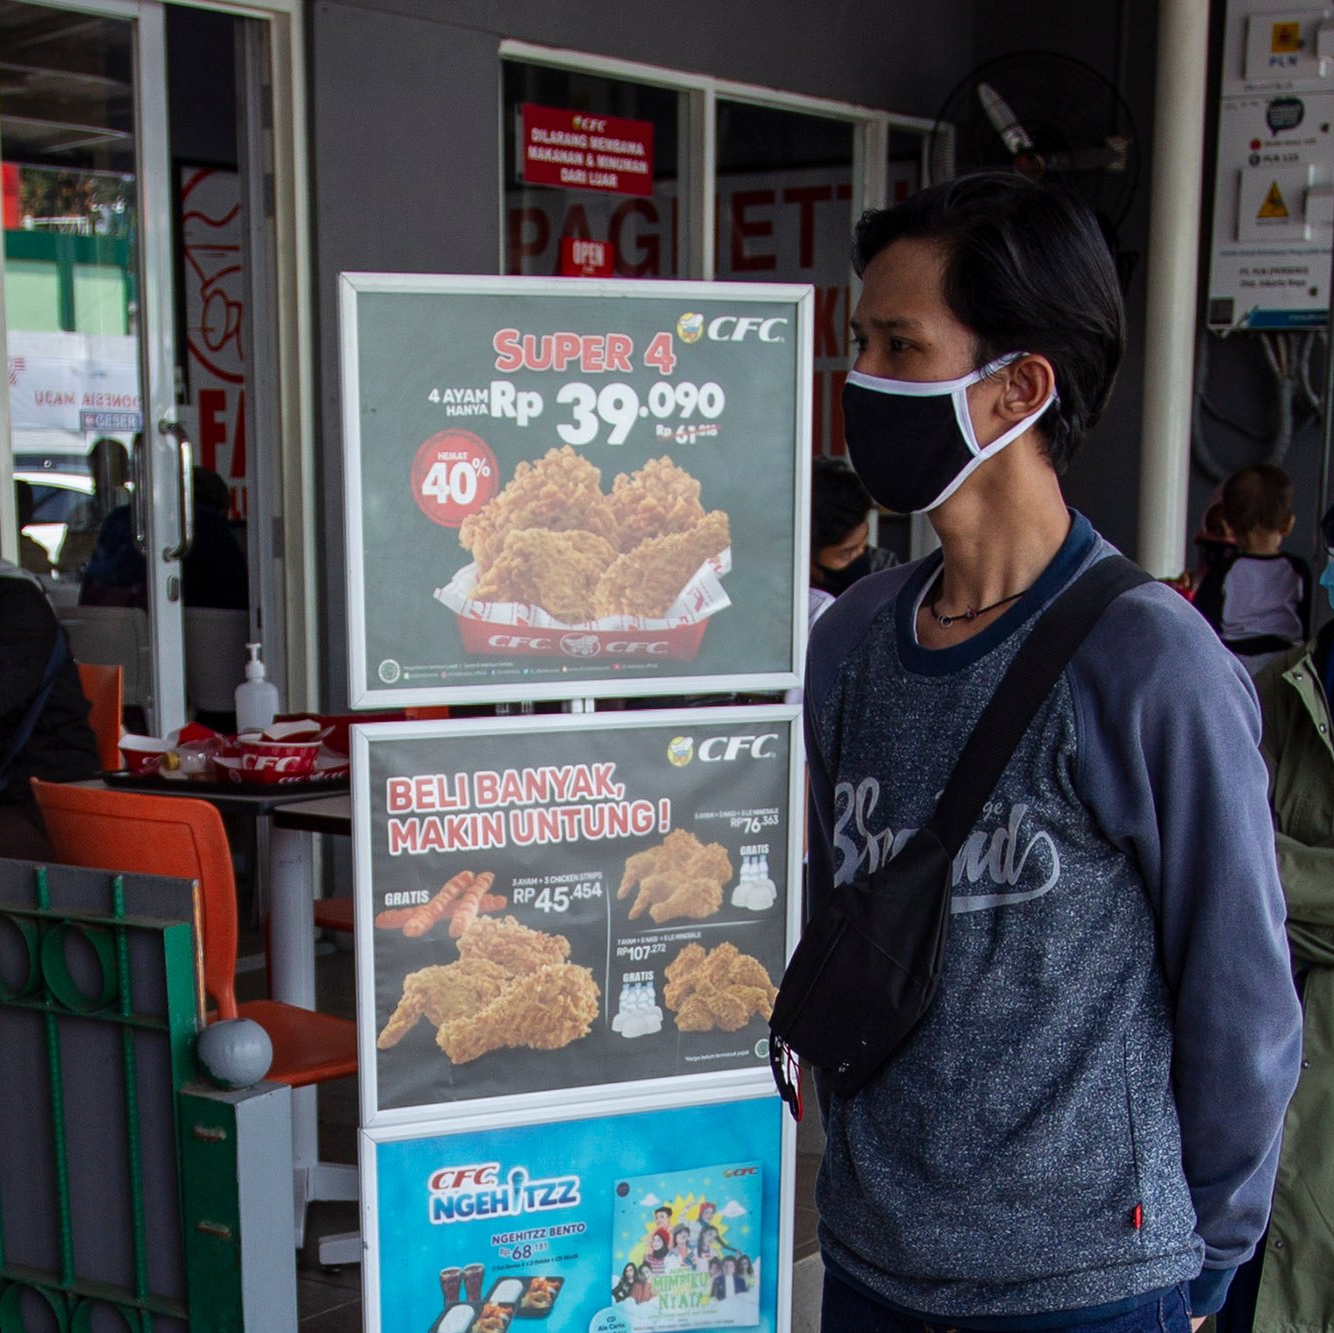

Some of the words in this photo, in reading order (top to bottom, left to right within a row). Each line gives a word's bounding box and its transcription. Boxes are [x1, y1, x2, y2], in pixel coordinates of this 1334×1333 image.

[531, 127, 587, 149] DILARANG
[589, 135, 645, 156] MEMBAWA
[528, 145, 584, 166] MAKANAN
[586, 152, 595, 168] &
[596, 153, 648, 174] MINUMAN
[560, 167, 587, 185] DARI
[588, 170, 618, 188] LUAR
[572, 240, 605, 267] OPEN
[707, 315, 788, 342] CFC
[494, 328, 633, 374] SUPER
[643, 331, 676, 375] 4
[428, 388, 441, 404] 4
[443, 388, 489, 404] AYAM
[95, 413, 136, 428] GESER
[446, 403, 489, 417] HANYA
[490, 380, 544, 426] Rp
[556, 381, 725, 446] 39.090
[437, 451, 468, 461] HEMAT
[421, 457, 491, 506] 40%
[488, 634, 551, 650] CFC
[605, 641, 670, 655] CFC
[698, 734, 779, 762] CFC
[242, 754, 301, 772] CFC
[386, 773, 468, 815] BELI
[474, 763, 625, 811] BANYAK,
[388, 814, 503, 855] MAKIN
[740, 844, 769, 856] GRATIS
[518, 876, 538, 887] AYAM
[550, 873, 579, 885] CHICKEN
[579, 871, 602, 882] STRIPS
[384, 890, 429, 906] GRATIS
[622, 970, 654, 983] GRATIS
[431, 1166, 497, 1191] CFC
[732, 1166, 760, 1177] CFC
[491, 1229, 547, 1245] NGEHITZZ
[549, 1223, 586, 1237] BENTO
[499, 1247, 510, 1257] Rp
